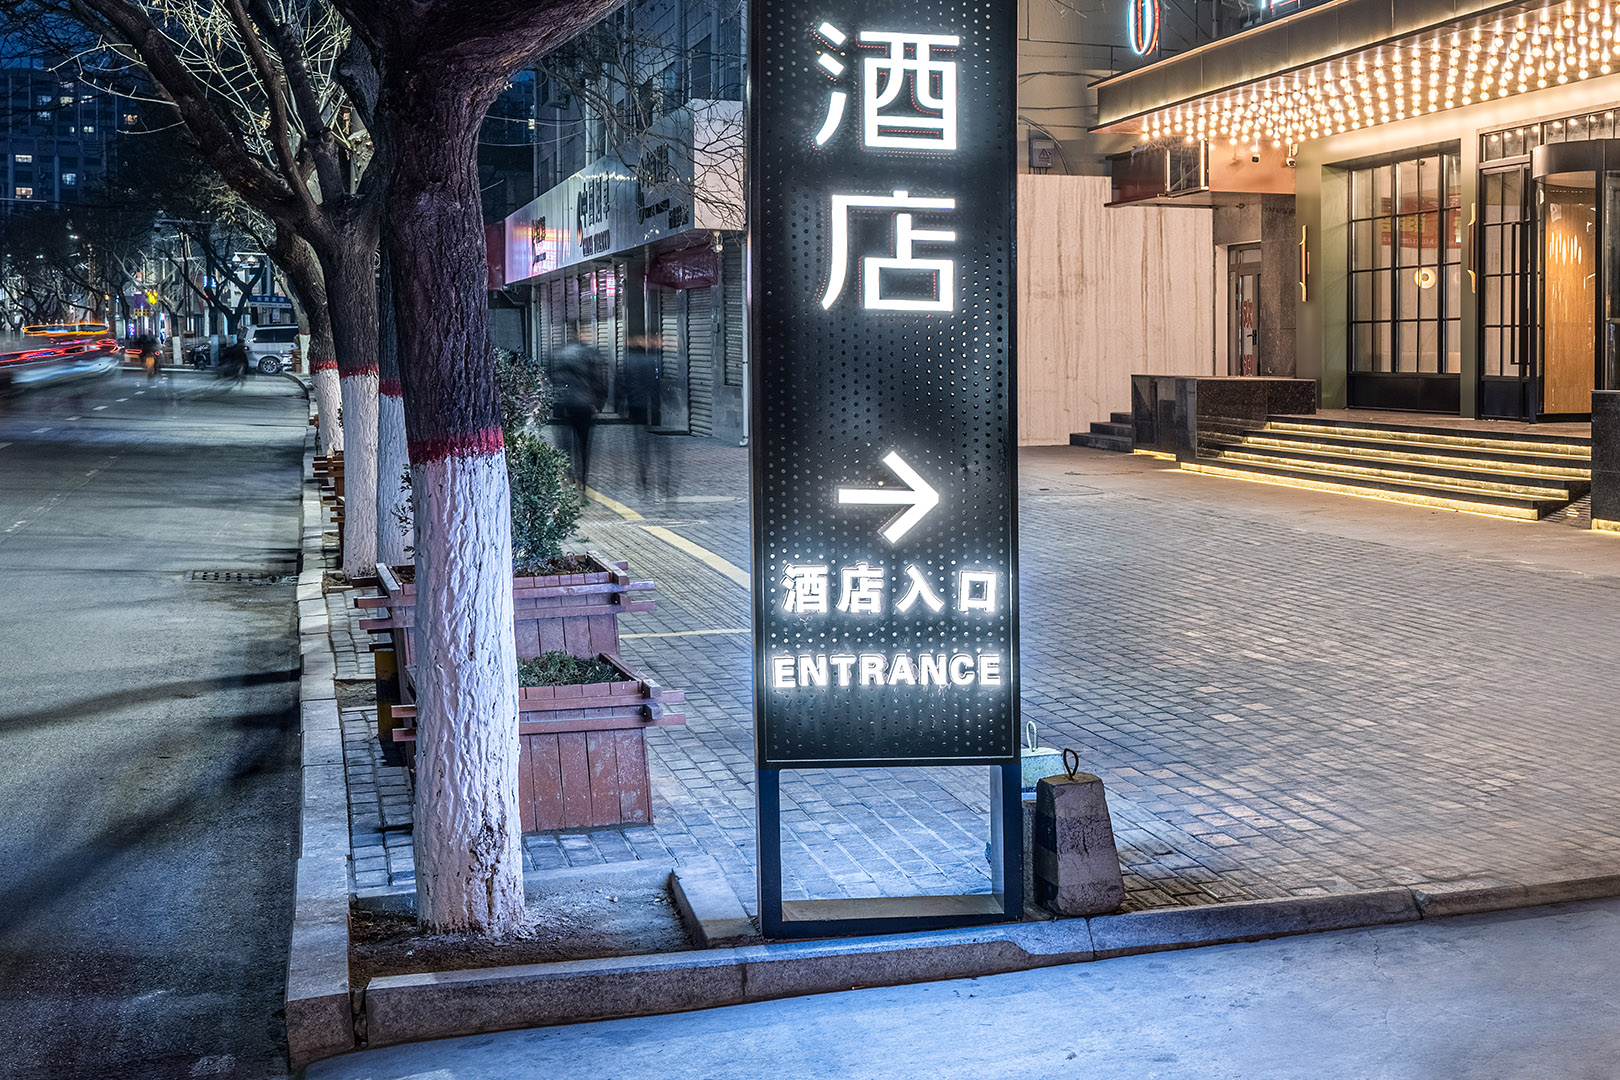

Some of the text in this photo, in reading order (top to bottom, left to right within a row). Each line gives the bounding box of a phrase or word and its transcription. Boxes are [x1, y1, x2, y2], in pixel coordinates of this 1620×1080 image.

[780, 564, 998, 615] 酒店入口
[771, 653, 1002, 689] ENTRANCE
